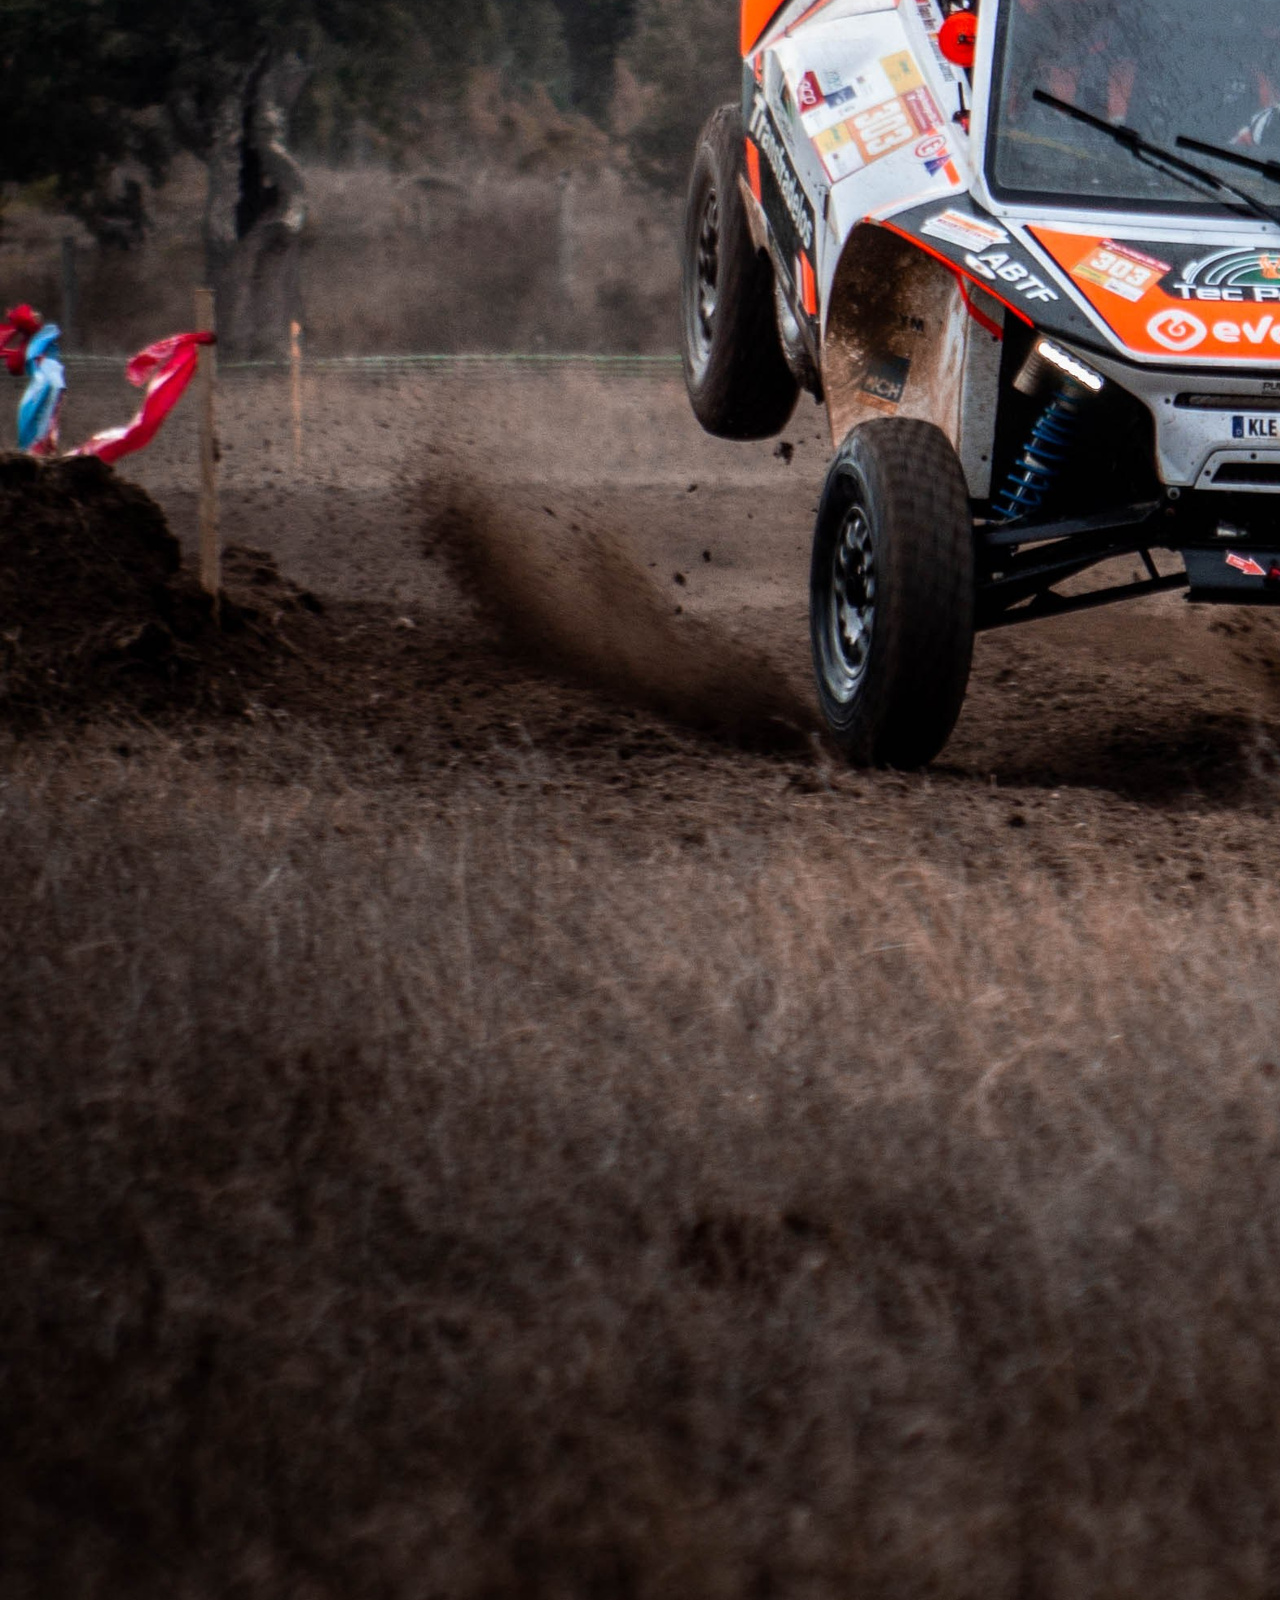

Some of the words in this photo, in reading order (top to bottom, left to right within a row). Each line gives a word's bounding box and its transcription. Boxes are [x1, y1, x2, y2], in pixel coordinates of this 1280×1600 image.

[853, 101, 914, 156] 303
[978, 252, 1059, 303] ABTF
[1090, 250, 1152, 288] 303
[1173, 284, 1244, 302] Tec
[1248, 418, 1278, 437] KLE
